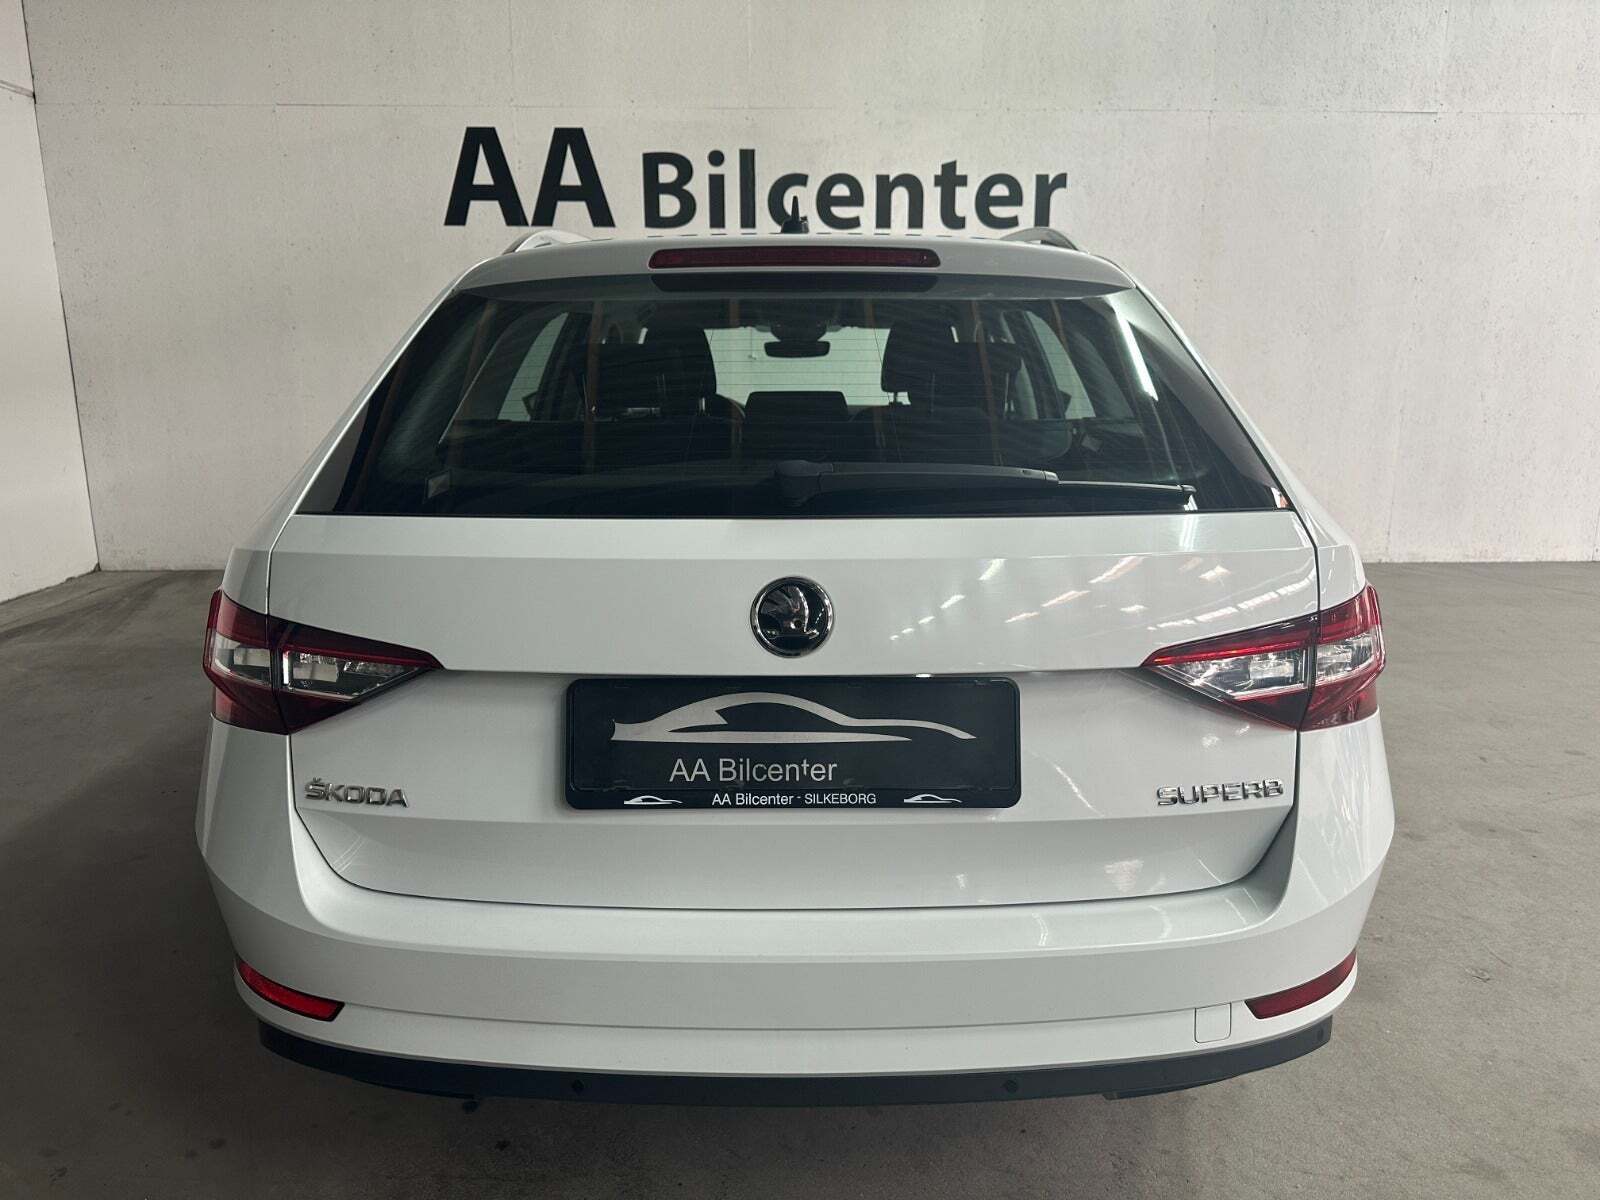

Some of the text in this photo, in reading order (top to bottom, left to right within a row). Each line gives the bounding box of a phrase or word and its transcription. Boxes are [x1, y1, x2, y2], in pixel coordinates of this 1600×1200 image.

[443, 126, 1068, 230] AA Bilcenter
[669, 757, 838, 783] AA Bilcenter
[304, 777, 409, 808] ŠKODA
[711, 793, 732, 806] AA
[734, 792, 795, 806] Bilcenter
[804, 792, 877, 806] SILKEBORG
[1157, 779, 1284, 806] SUPERB
